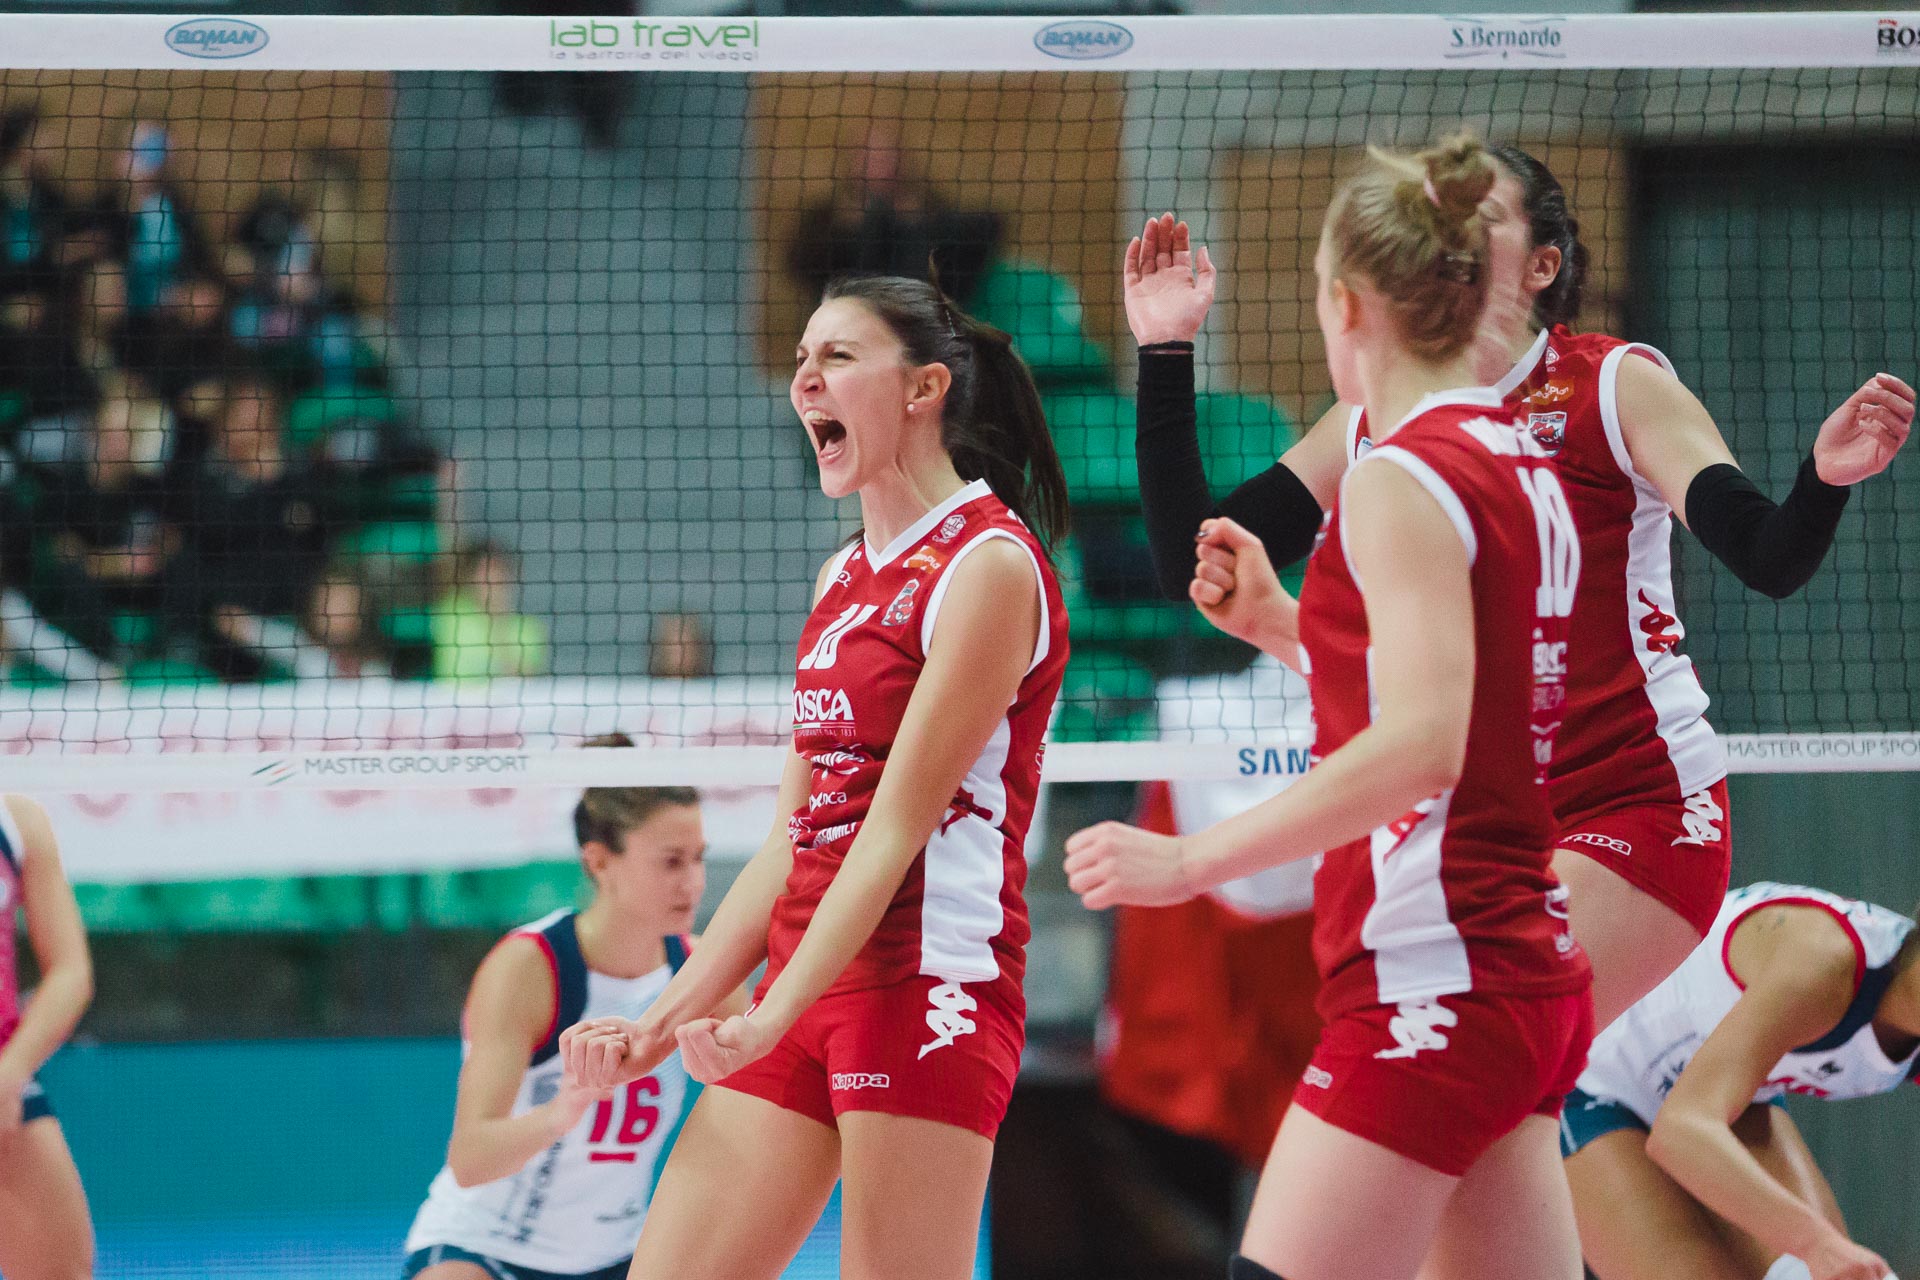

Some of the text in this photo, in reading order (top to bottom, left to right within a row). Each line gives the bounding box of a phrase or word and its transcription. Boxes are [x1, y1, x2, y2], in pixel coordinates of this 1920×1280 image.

[551, 20, 758, 47] lab travel
[1471, 26, 1561, 48] Bernardo
[1877, 27, 1920, 47] BO
[793, 688, 854, 721] OSCA
[1727, 740, 1800, 758] MASTER
[1807, 738, 1876, 758] GROUP
[304, 755, 530, 775] MASTER GROUP SPORT
[832, 1073, 890, 1091] Kappa
[588, 1076, 660, 1144] 16
